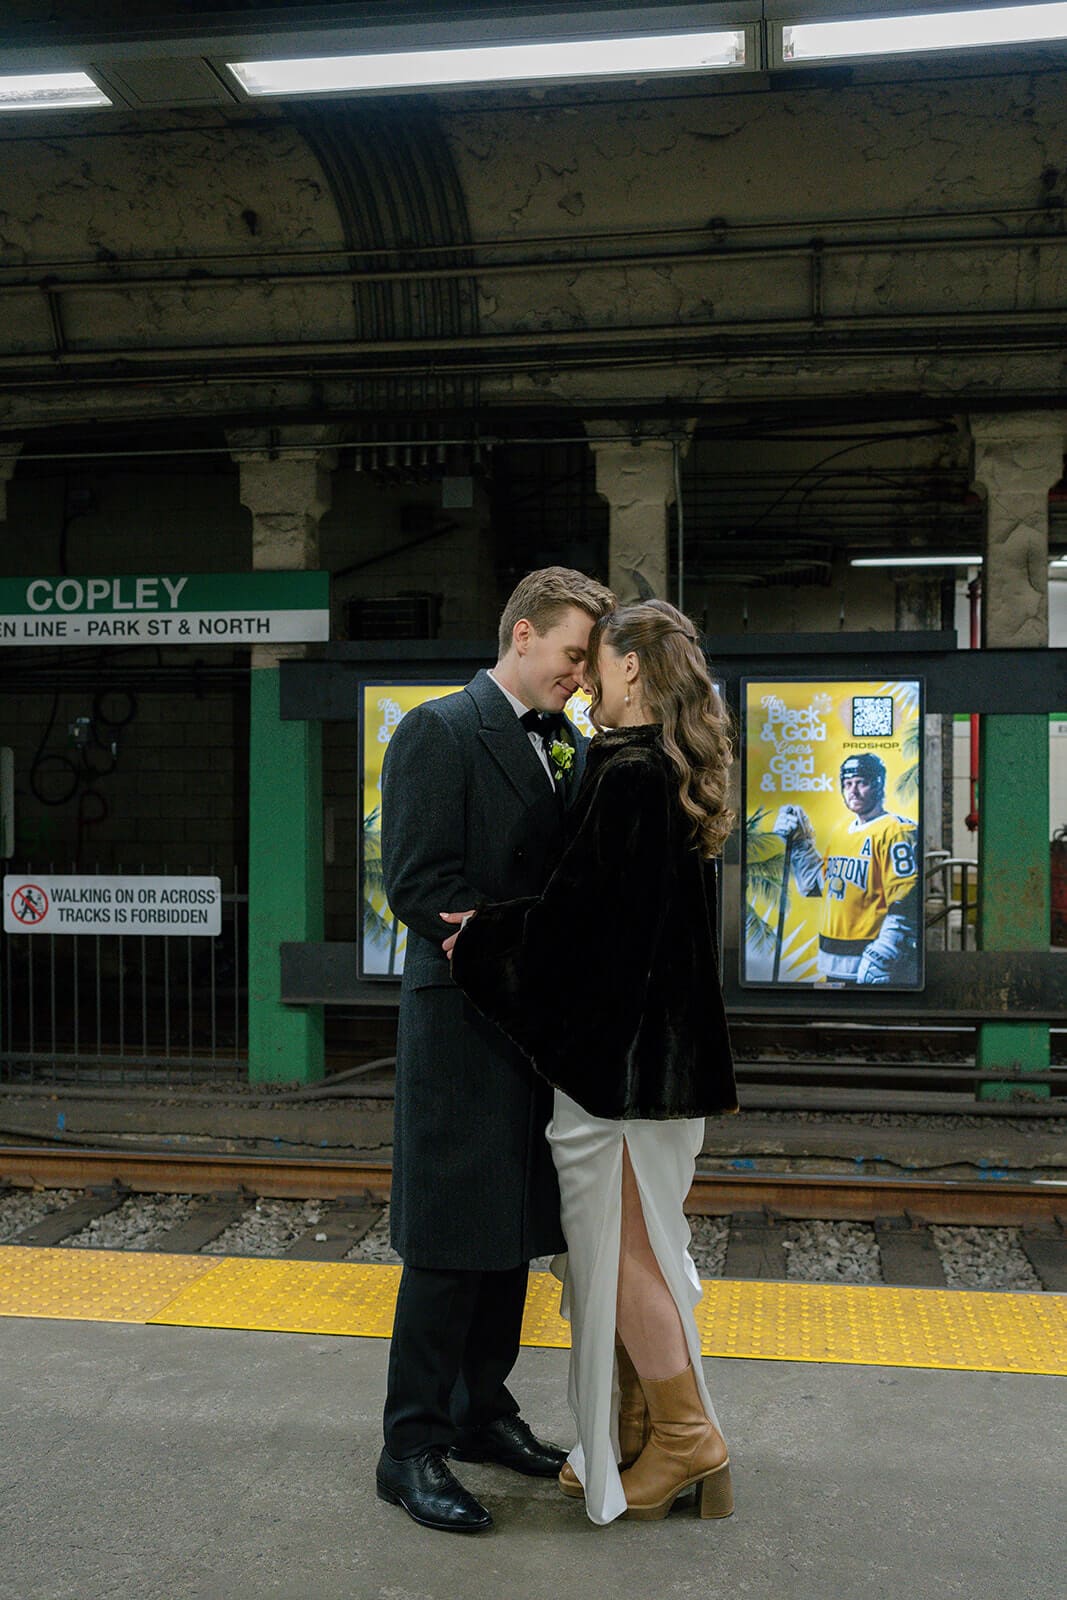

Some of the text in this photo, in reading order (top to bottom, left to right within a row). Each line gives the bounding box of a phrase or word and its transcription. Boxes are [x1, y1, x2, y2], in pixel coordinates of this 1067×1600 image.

[26, 577, 189, 612] COPLEY
[24, 621, 67, 637] LINE
[87, 620, 140, 636] PARK
[147, 619, 172, 636] ST
[178, 618, 191, 635] &
[199, 617, 270, 635] NORTH
[768, 704, 820, 724] Black
[760, 723, 827, 742] & Gold
[769, 755, 815, 775] Gold
[760, 773, 834, 792] & Black
[50, 888, 216, 904] WALKING ON OR ACROSS
[57, 908, 208, 924] TRACKS IS FORBIDDEN
